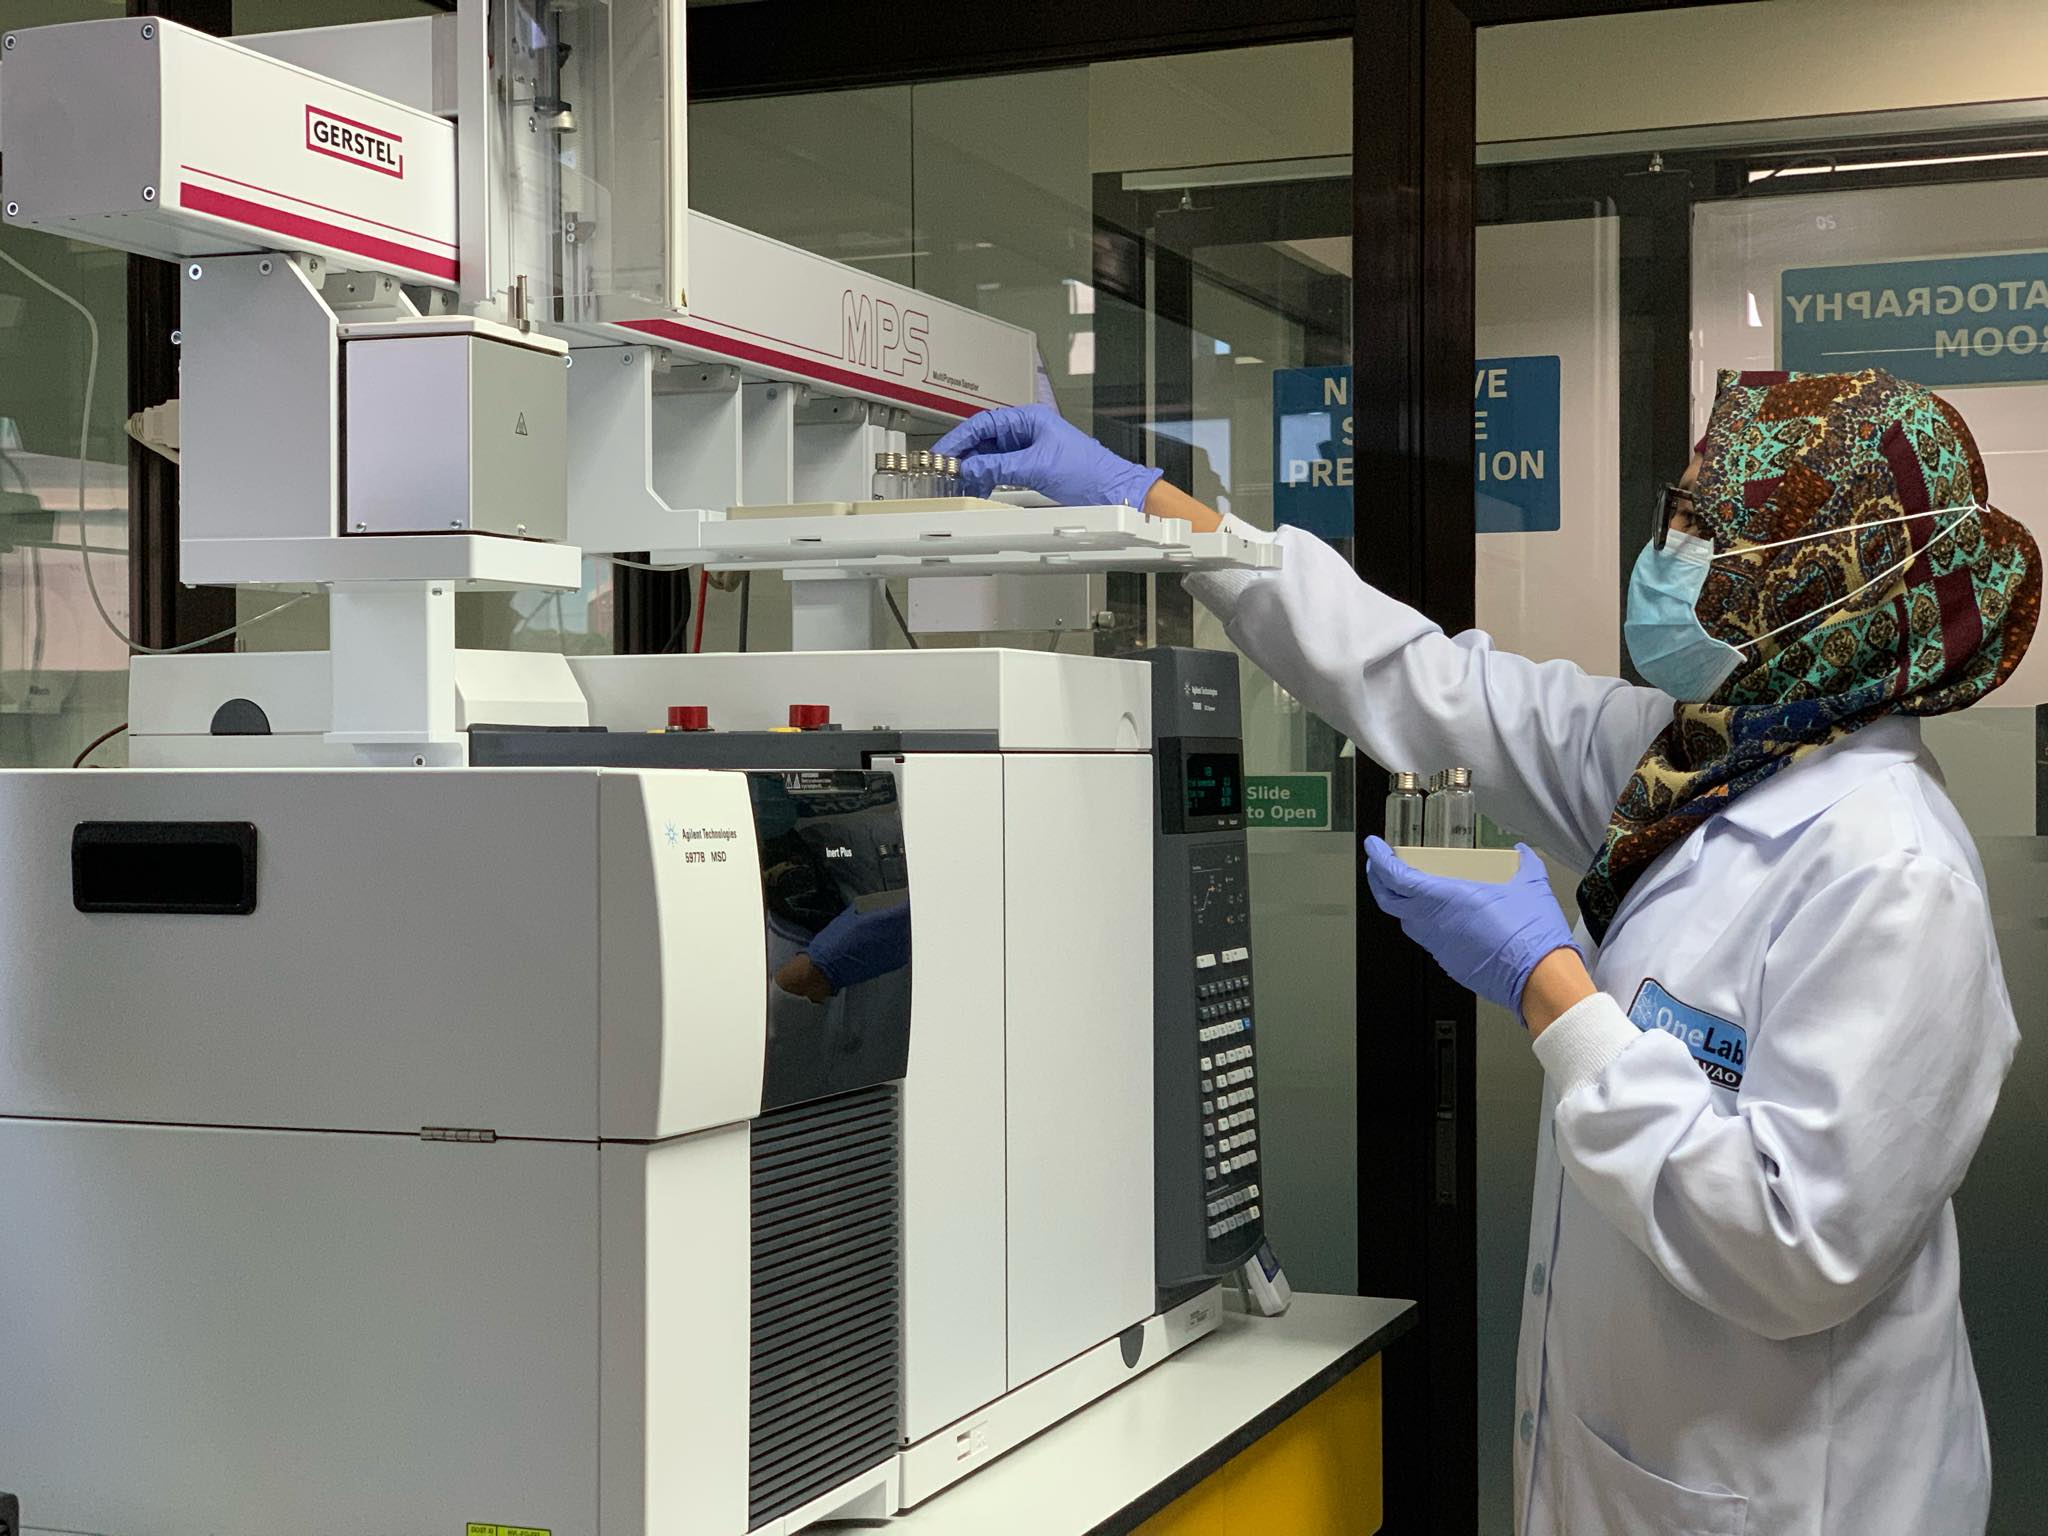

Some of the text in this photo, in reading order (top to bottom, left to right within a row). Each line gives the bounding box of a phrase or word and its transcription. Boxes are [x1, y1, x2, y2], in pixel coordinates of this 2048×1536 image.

[313, 120, 396, 166] GERSTEL
[842, 289, 930, 380] MPS
[1247, 785, 1291, 800] Slide
[1246, 805, 1316, 822] to Open
[682, 828, 737, 842] Agilent Technologies
[684, 851, 727, 864] 5977B MSD
[825, 846, 853, 858] Inert Plus
[1656, 1006, 1744, 1065] OneLab
[1702, 1062, 1737, 1083] VAO
